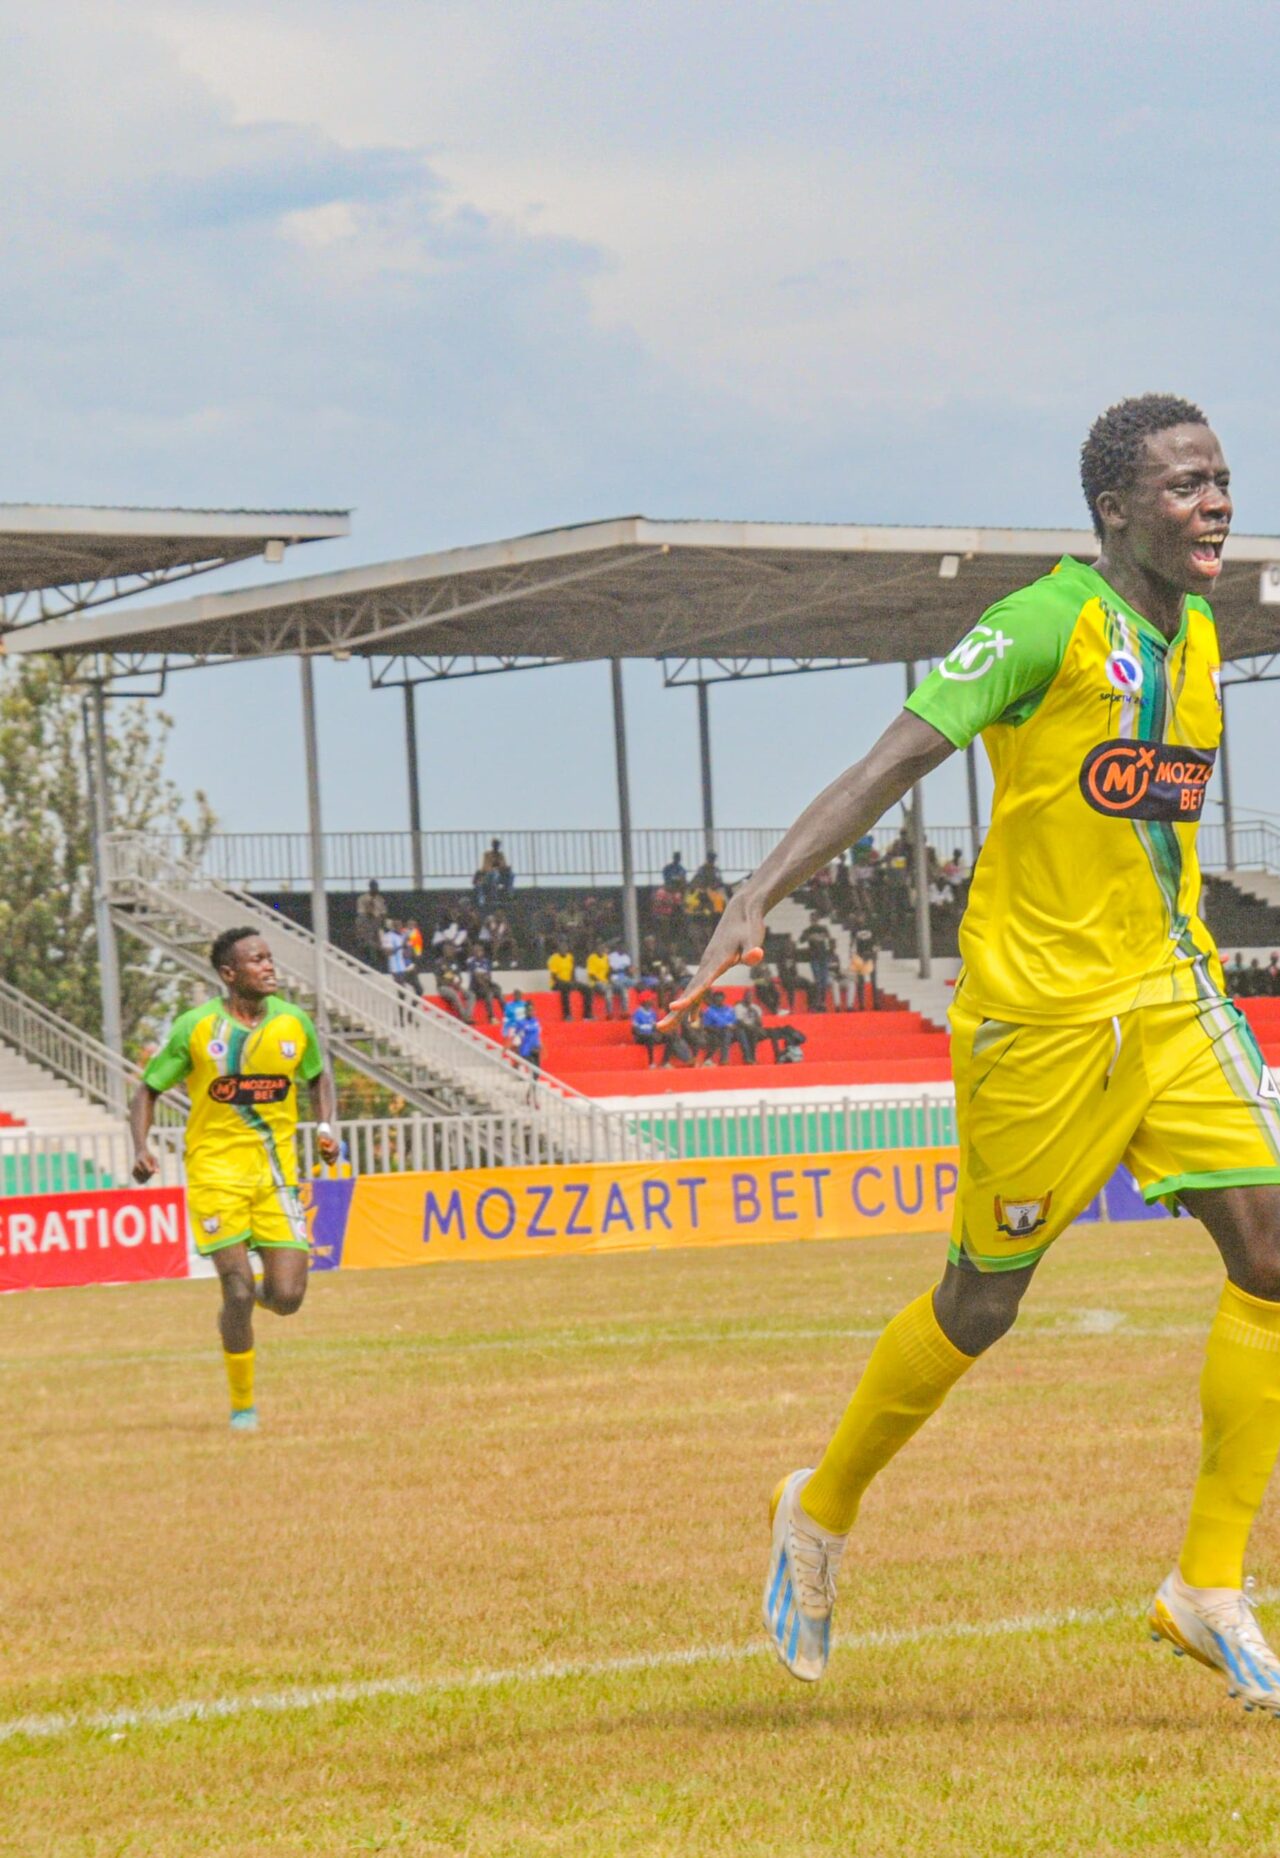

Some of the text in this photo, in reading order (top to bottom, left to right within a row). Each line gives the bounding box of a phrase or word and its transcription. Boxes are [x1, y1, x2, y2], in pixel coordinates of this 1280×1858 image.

[0, 1203, 179, 1256] RATION
[422, 1162, 957, 1243] MOZZART BET CUP
